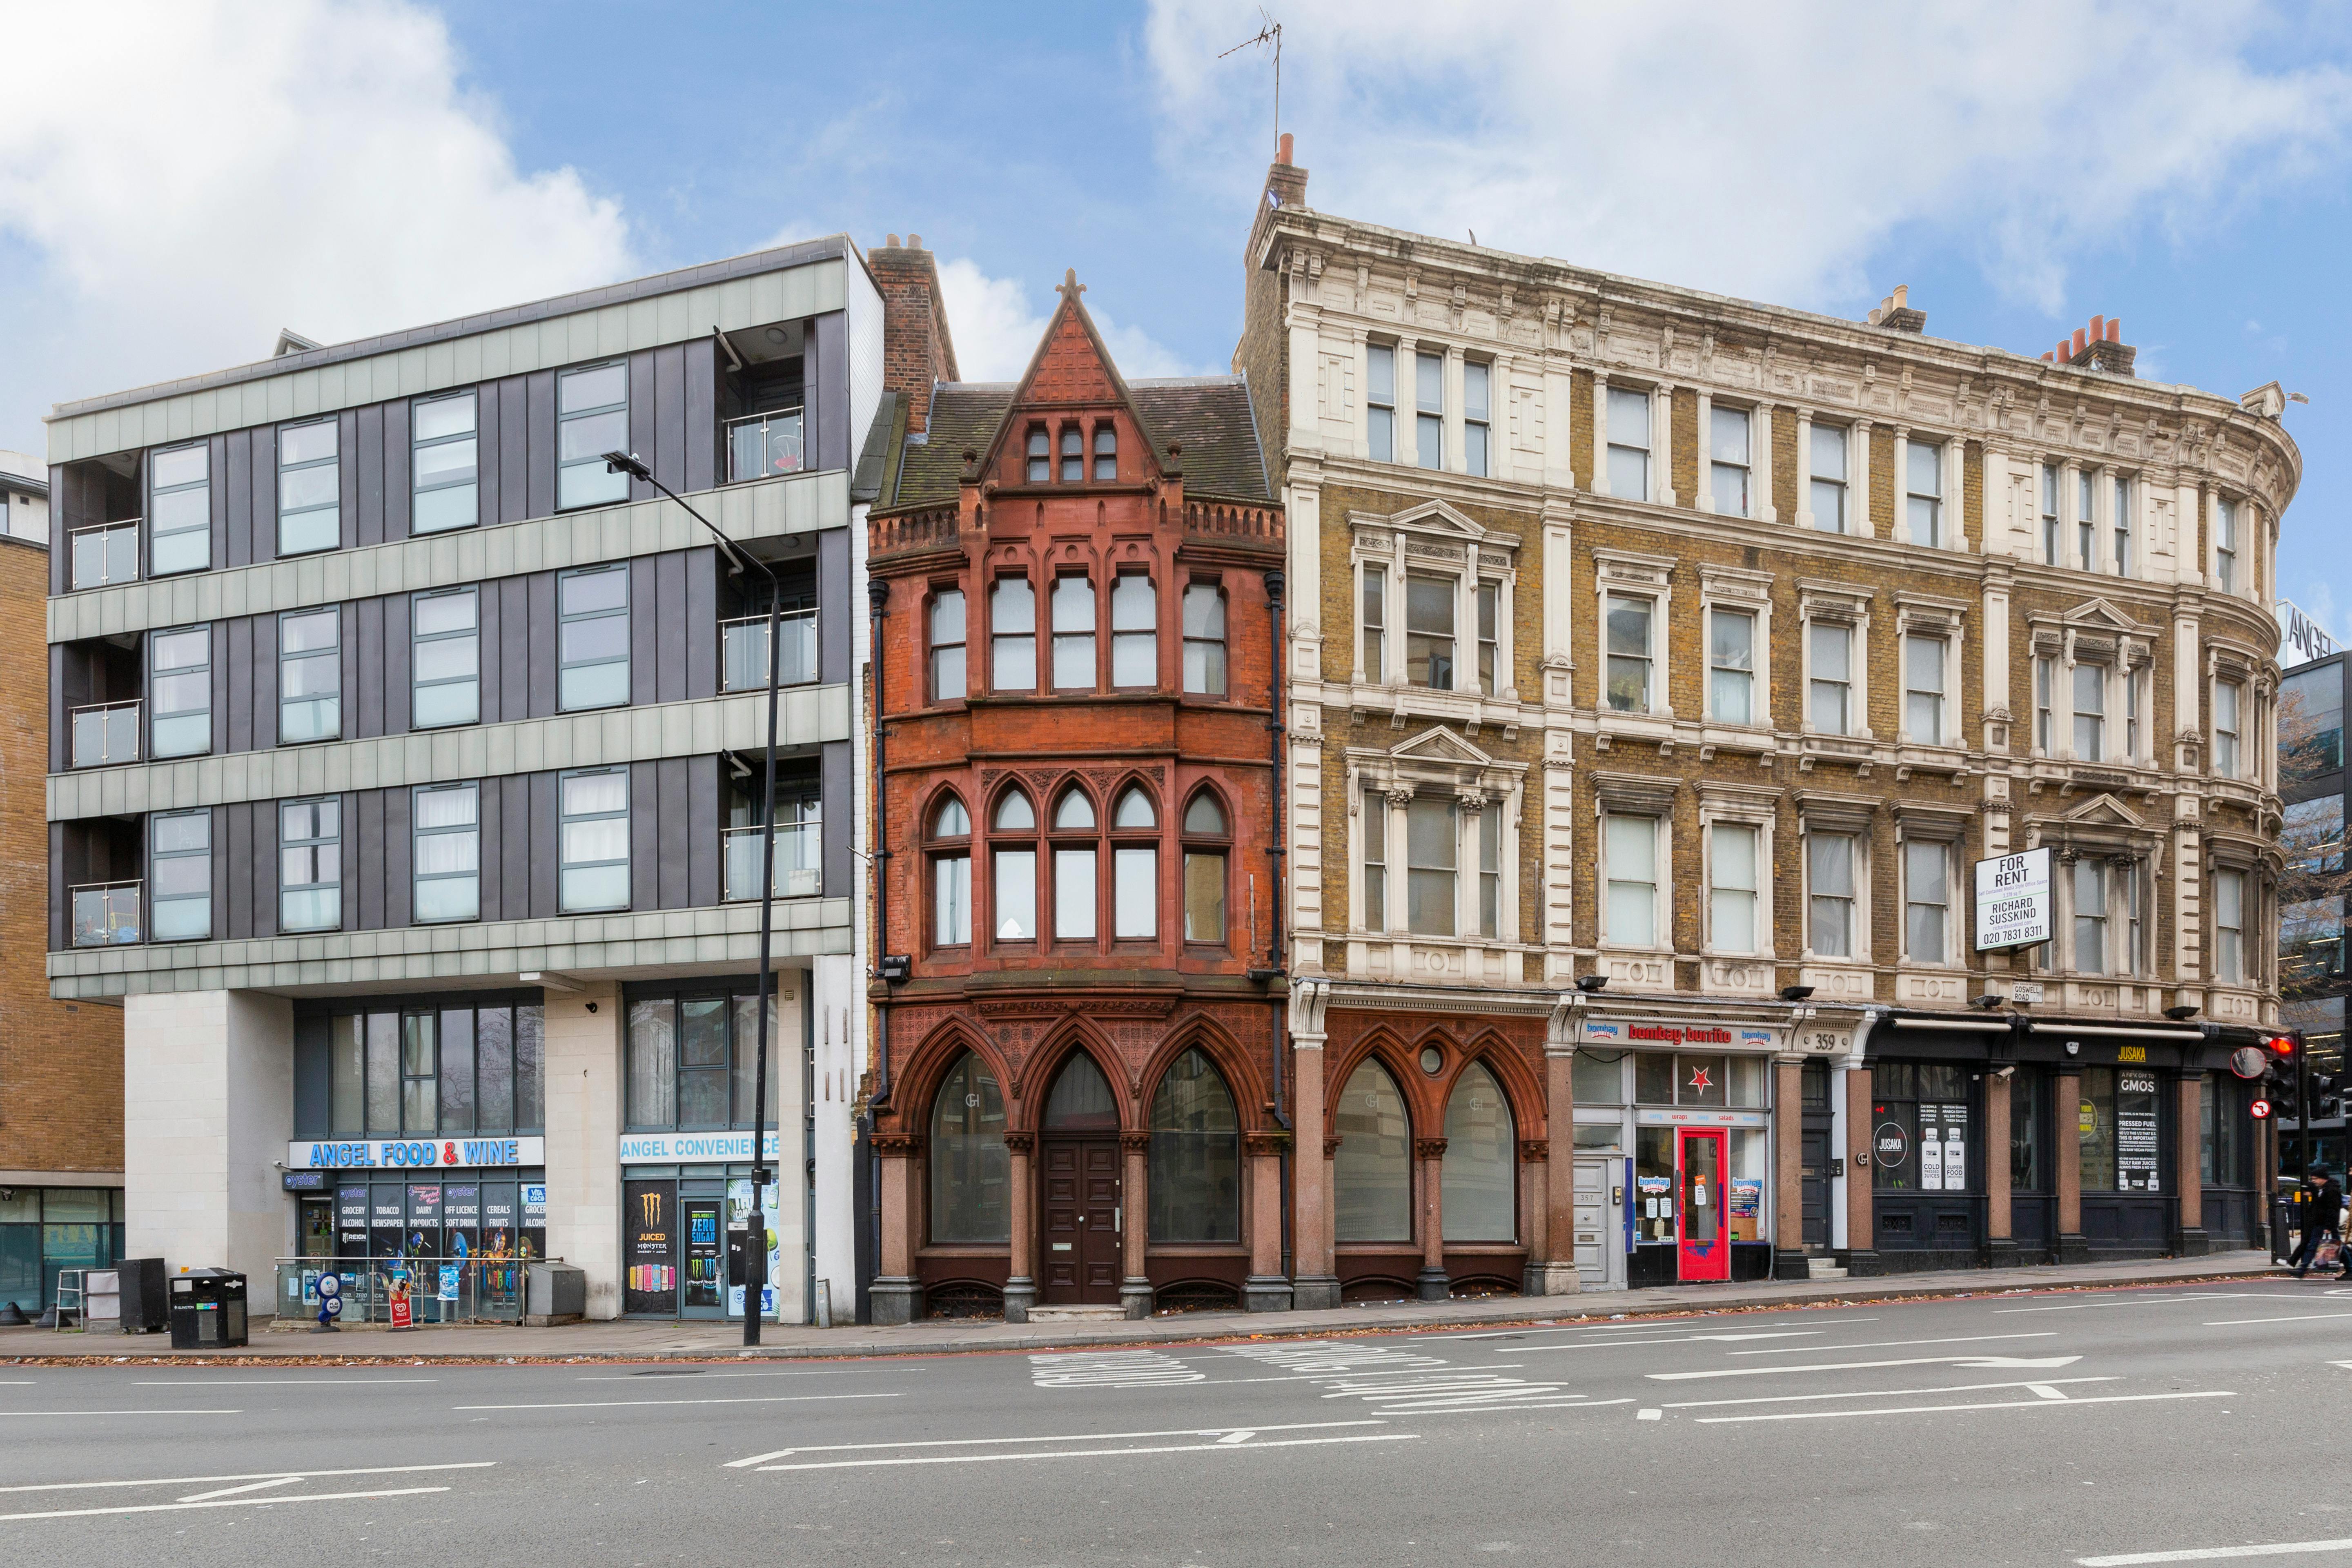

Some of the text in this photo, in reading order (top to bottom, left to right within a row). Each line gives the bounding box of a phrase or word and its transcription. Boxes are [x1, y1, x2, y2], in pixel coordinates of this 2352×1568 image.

[2000, 855, 2024, 872] FOR
[1996, 869, 2029, 887] RENT
[1993, 898, 2032, 913] RICHARD
[1989, 908, 2036, 925] SUSSKIND
[1993, 920, 2032, 931] richardsusskind.com
[1984, 925, 2042, 944] 020 7831 8311
[1587, 1023, 1618, 1035] bombay
[1629, 1024, 1731, 1045] bombay burrito
[1741, 1031, 1771, 1042] bombay
[1816, 1033, 1835, 1050] 359
[2118, 1046, 2146, 1060] JUSAKA
[2121, 1079, 2154, 1092] GMOS
[621, 1141, 668, 1157] ANGEL
[1879, 1138, 1902, 1149] JUSAKA
[310, 1140, 518, 1167] ANGEL FOOD & WINE
[286, 1173, 318, 1188] oyster
[1639, 1178, 1669, 1187] bombay
[1734, 1179, 1762, 1189] bombay
[340, 1188, 366, 1200] oyster
[447, 1187, 474, 1198] oyster
[445, 1206, 477, 1214] OFF LICENCE
[487, 1206, 510, 1214] CEREALS
[489, 1218, 508, 1227] FRUITS
[692, 1218, 715, 1232] ZERO
[692, 1232, 715, 1242] SUGAR
